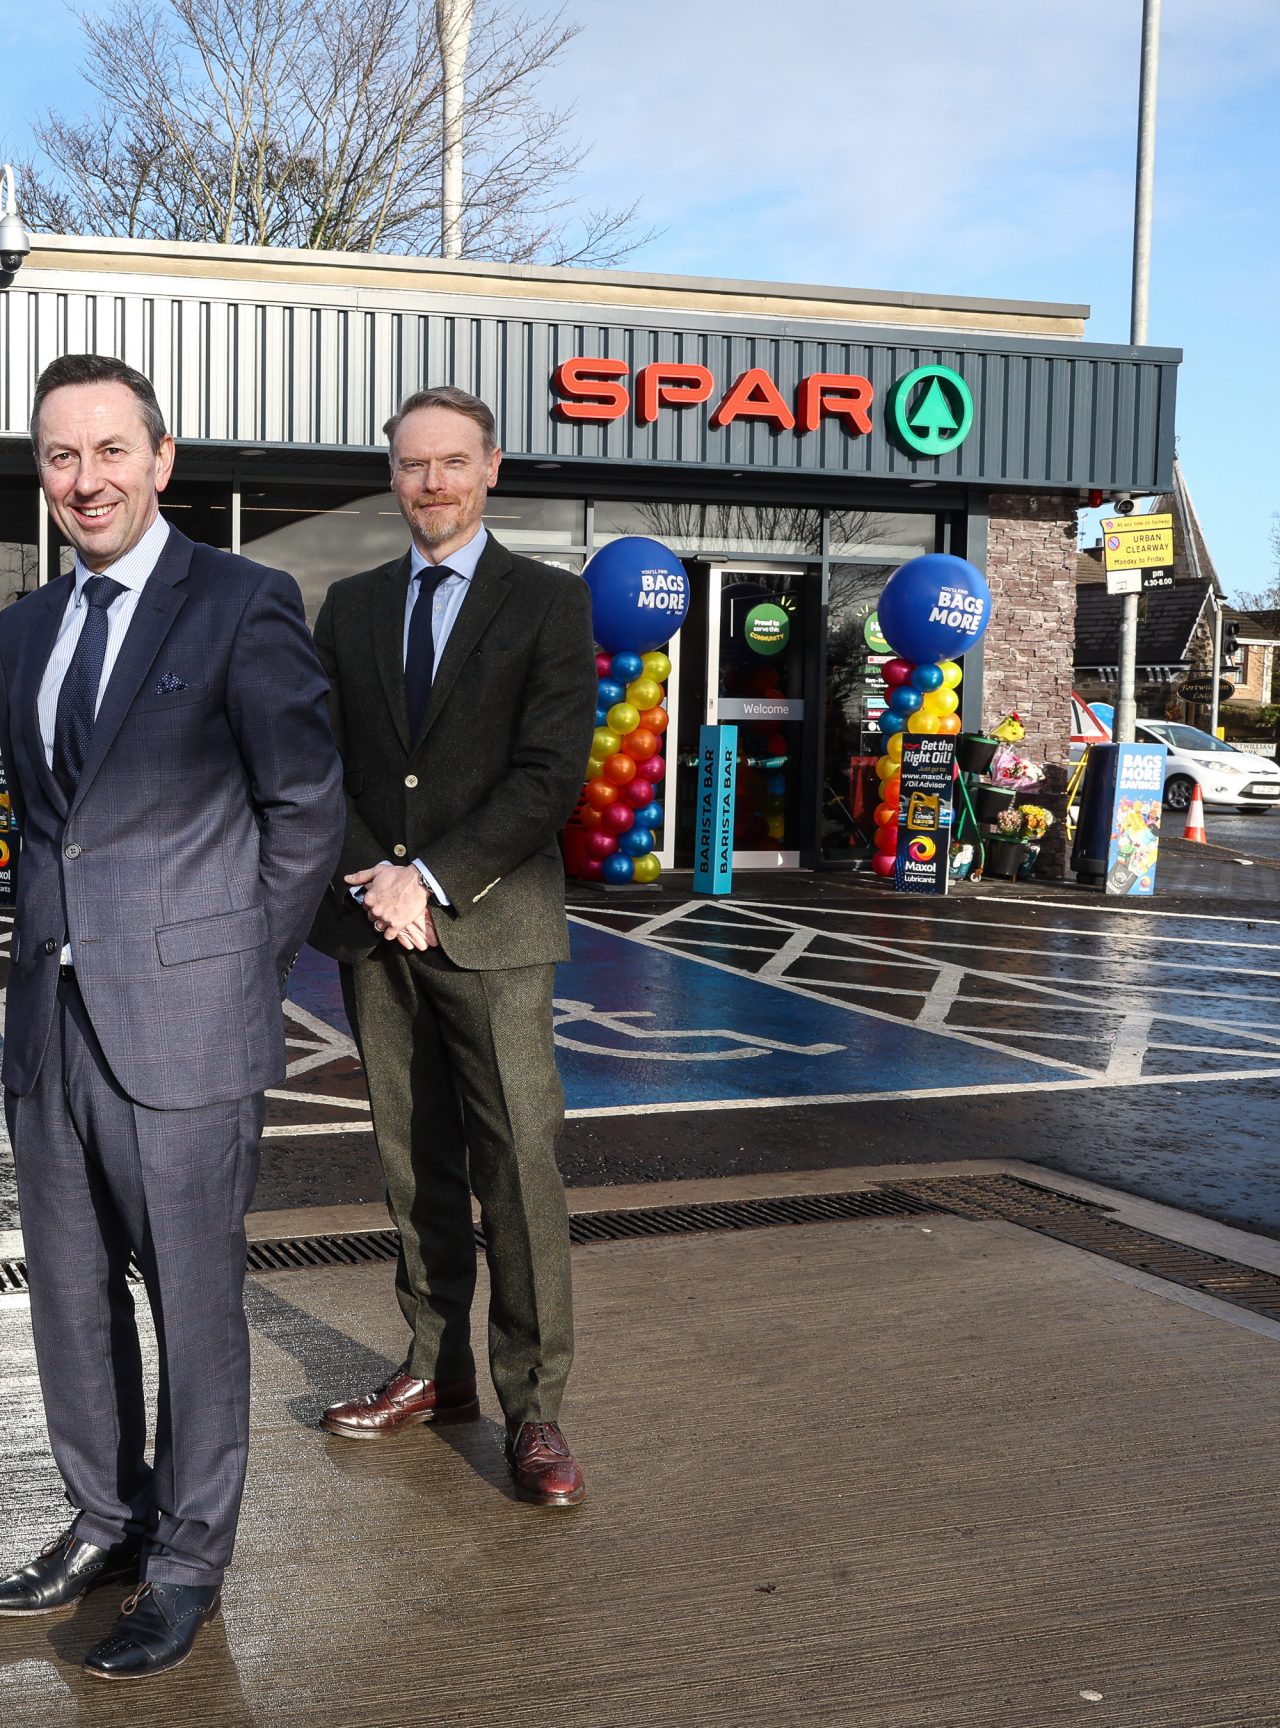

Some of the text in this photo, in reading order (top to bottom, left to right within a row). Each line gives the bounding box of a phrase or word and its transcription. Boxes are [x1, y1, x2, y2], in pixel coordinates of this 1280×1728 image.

[552, 356, 875, 436] SPAR
[1133, 533, 1162, 543] URBAN
[1125, 543, 1169, 554] CLEARWAY
[1152, 570, 1164, 579] pm
[641, 574, 685, 592] BAGS
[637, 591, 685, 610] MORE
[938, 591, 984, 615] BAGS
[928, 607, 982, 631] MORE
[743, 703, 790, 715] Welcome
[921, 739, 954, 751] Get the
[903, 750, 952, 767] Right Oil!
[1123, 754, 1163, 769] BAGS
[703, 748, 714, 788] BAR
[723, 749, 733, 789] BAR
[1121, 767, 1162, 780] MORE
[902, 773, 952, 781] www.maxol.ie
[919, 781, 947, 789] Advisor
[1119, 779, 1161, 791] SAVINGS
[699, 792, 713, 874] BARISTA
[720, 793, 731, 874] BARISTA
[905, 860, 937, 873] Maxol
[904, 874, 936, 885] Lubricants
